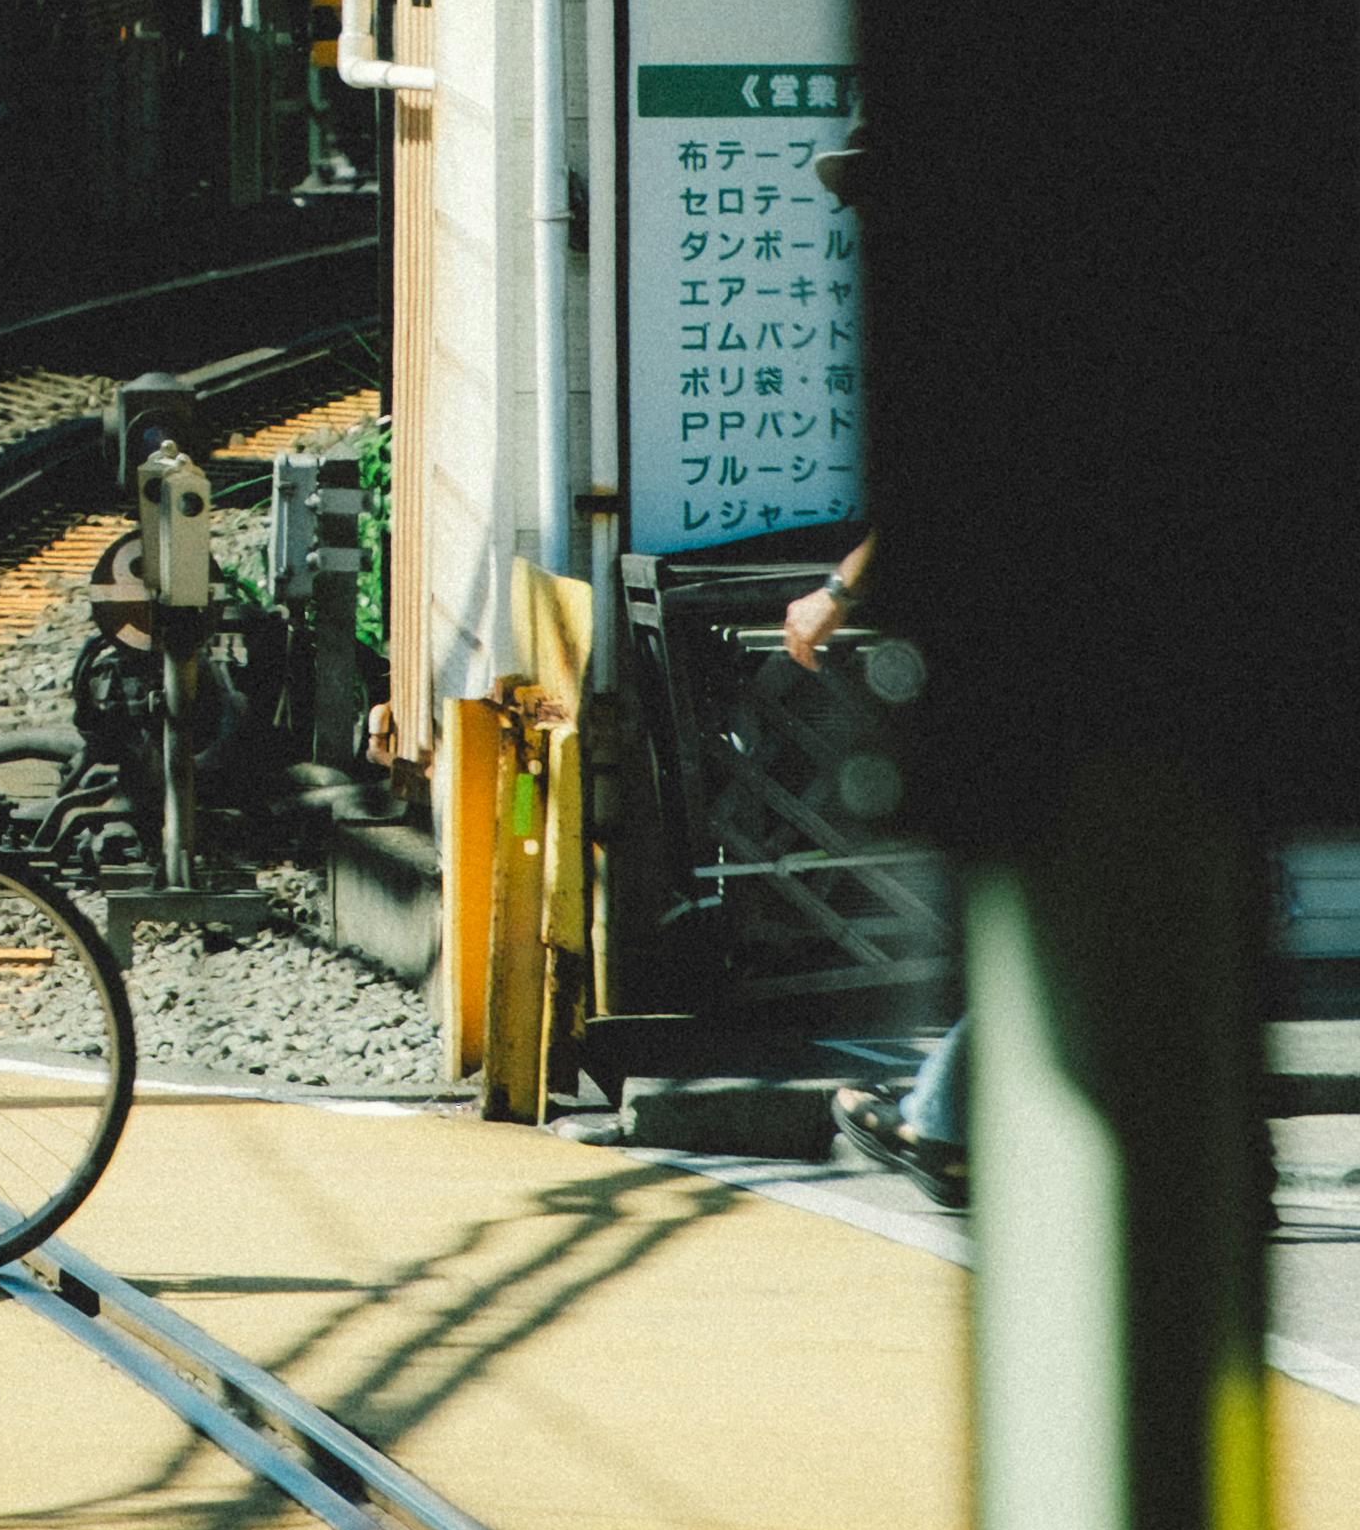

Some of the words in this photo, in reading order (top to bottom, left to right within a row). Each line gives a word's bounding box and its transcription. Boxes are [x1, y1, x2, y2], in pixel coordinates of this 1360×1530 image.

[678, 139, 816, 172] 布テープ
[679, 186, 850, 215] セロテー
[681, 230, 854, 261] ダンボール
[682, 319, 855, 351] ゴムバンド
[682, 455, 854, 486] ブルーシー
